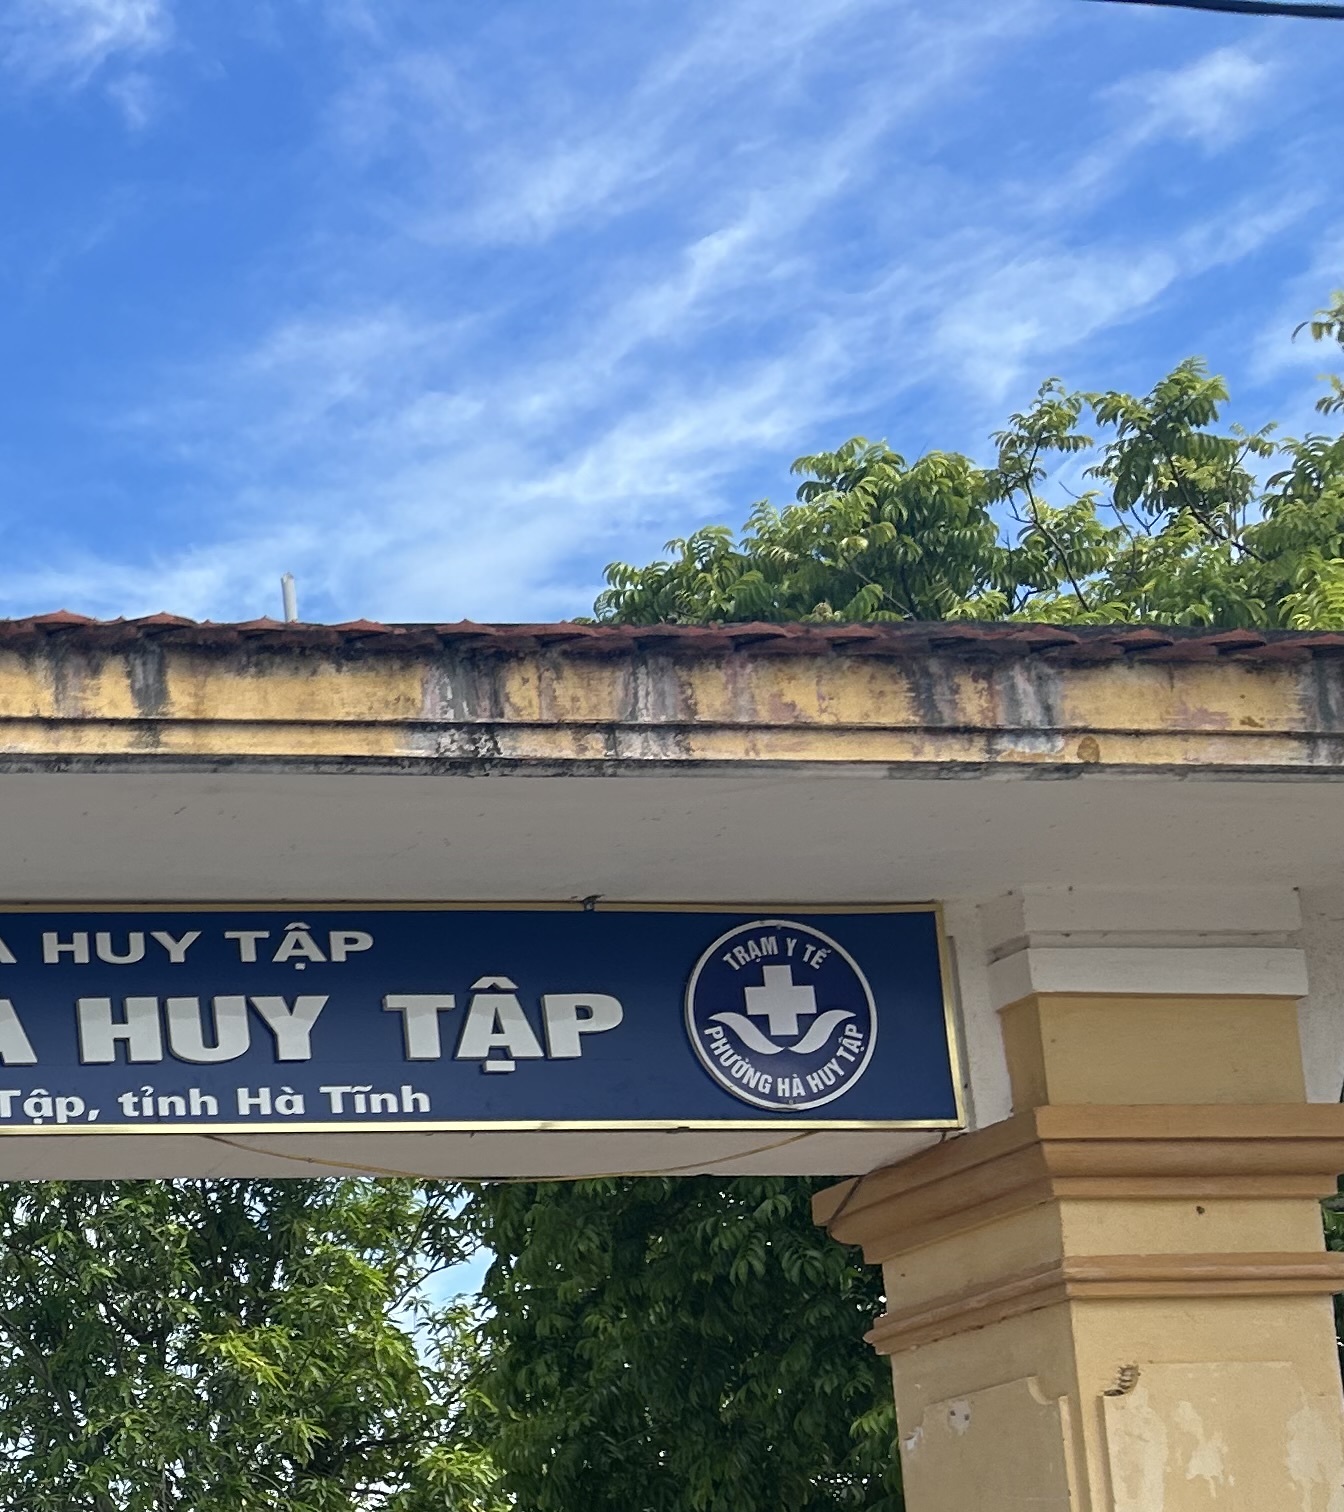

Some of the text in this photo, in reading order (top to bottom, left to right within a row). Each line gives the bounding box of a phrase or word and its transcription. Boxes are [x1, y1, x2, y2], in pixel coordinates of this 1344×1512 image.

[42, 930, 202, 965] HUY
[224, 922, 374, 970] TẬP
[722, 935, 832, 971] TRẠM Y TẾ
[78, 995, 330, 1063] HUY
[383, 976, 624, 1073] TẬP
[703, 1023, 865, 1098] PHƯỜNG HÀ HUY TẬP
[117, 1085, 218, 1117] tỉnh
[236, 1086, 306, 1116] Hà
[319, 1085, 431, 1114] Tĩnh
